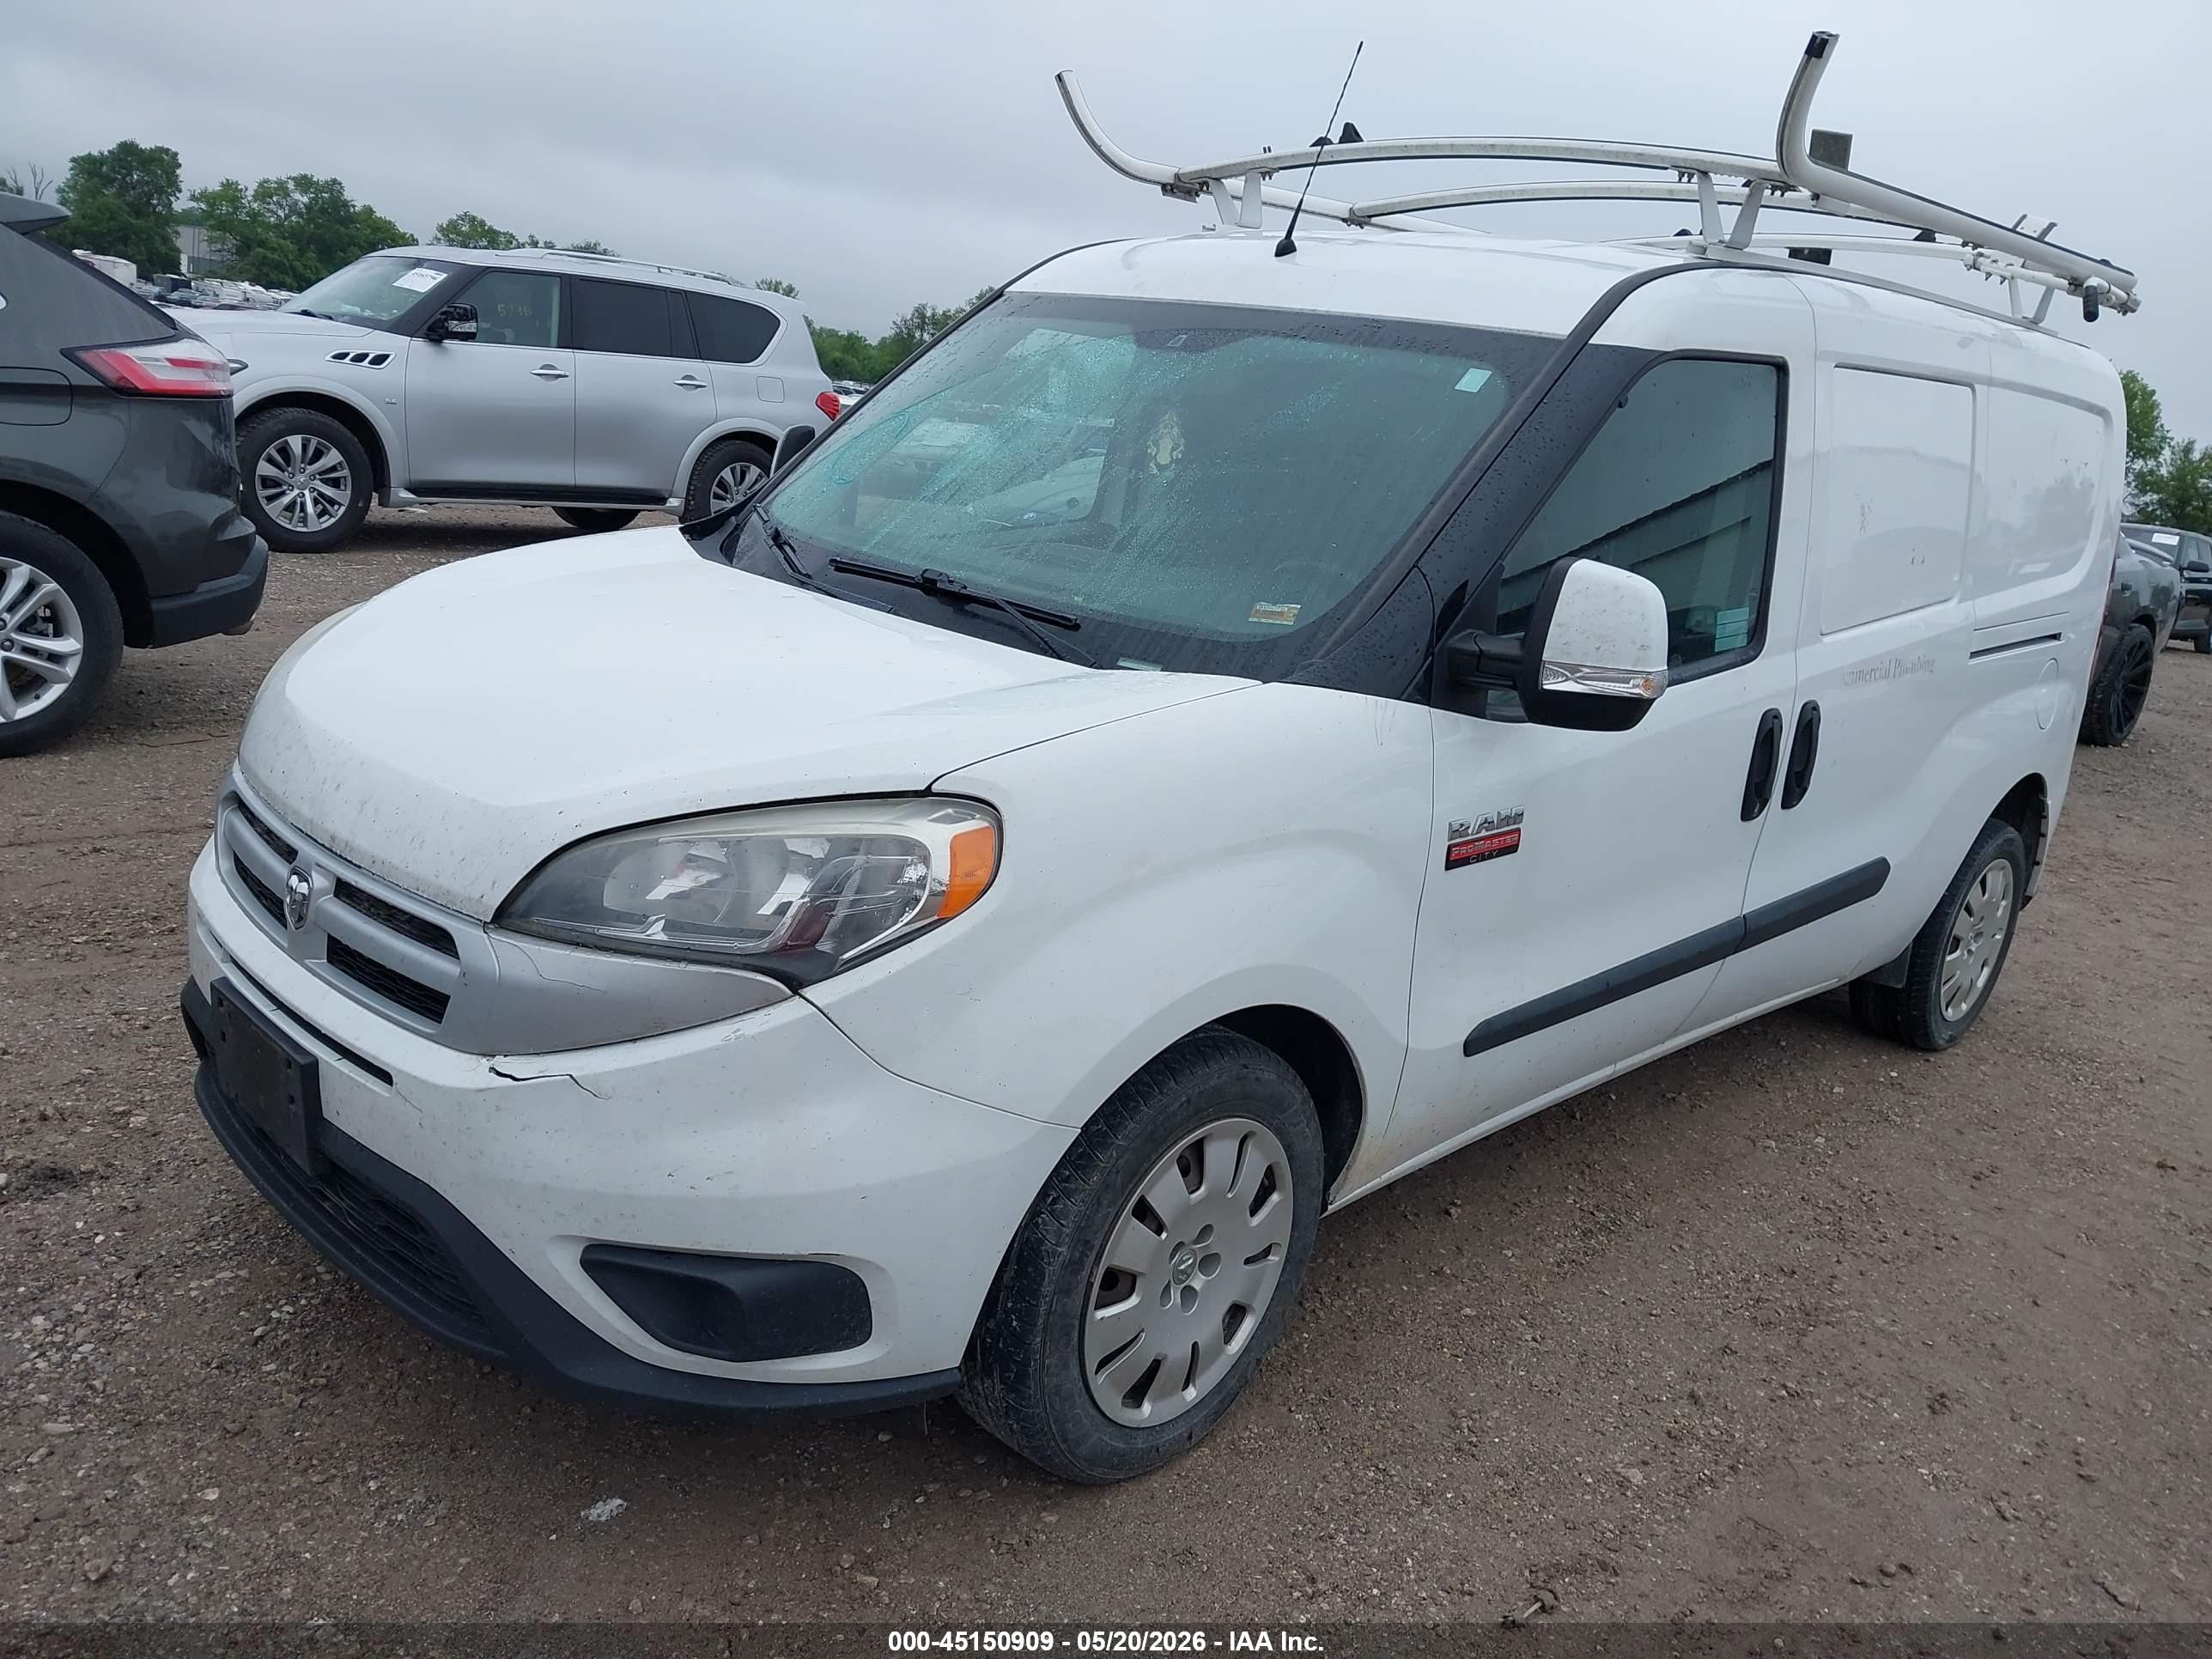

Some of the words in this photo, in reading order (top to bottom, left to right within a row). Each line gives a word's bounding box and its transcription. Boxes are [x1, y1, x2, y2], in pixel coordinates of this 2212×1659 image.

[1892, 654, 1936, 678] Plumbing
[1447, 805, 1525, 842] RAM
[1469, 850, 1499, 863] CITY
